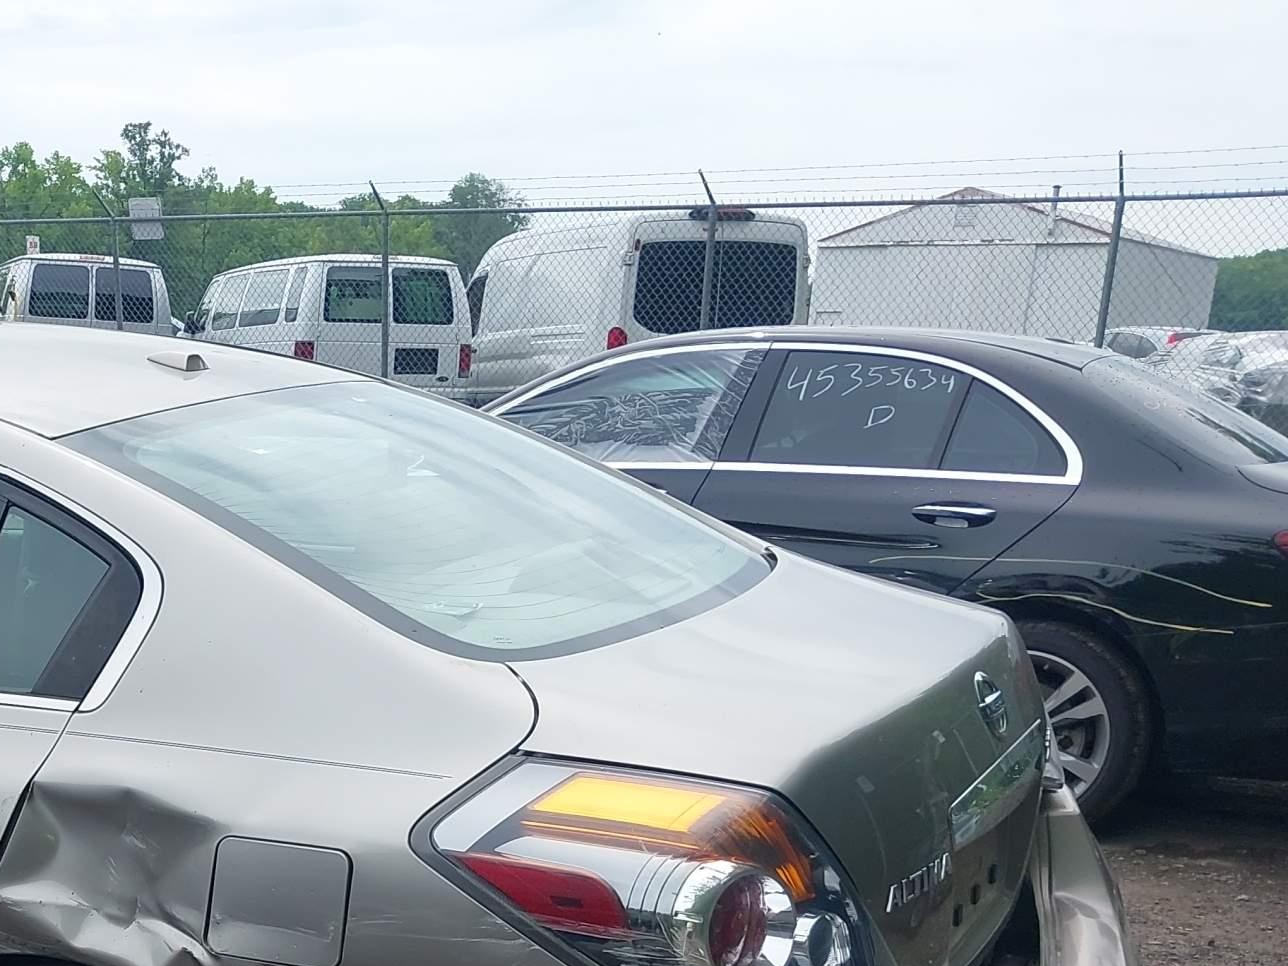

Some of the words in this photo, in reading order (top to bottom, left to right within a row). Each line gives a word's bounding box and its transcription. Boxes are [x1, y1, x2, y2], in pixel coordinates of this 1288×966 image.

[787, 363, 955, 400] 45355634
[863, 405, 896, 429] D
[885, 852, 952, 913] ALTIMA
